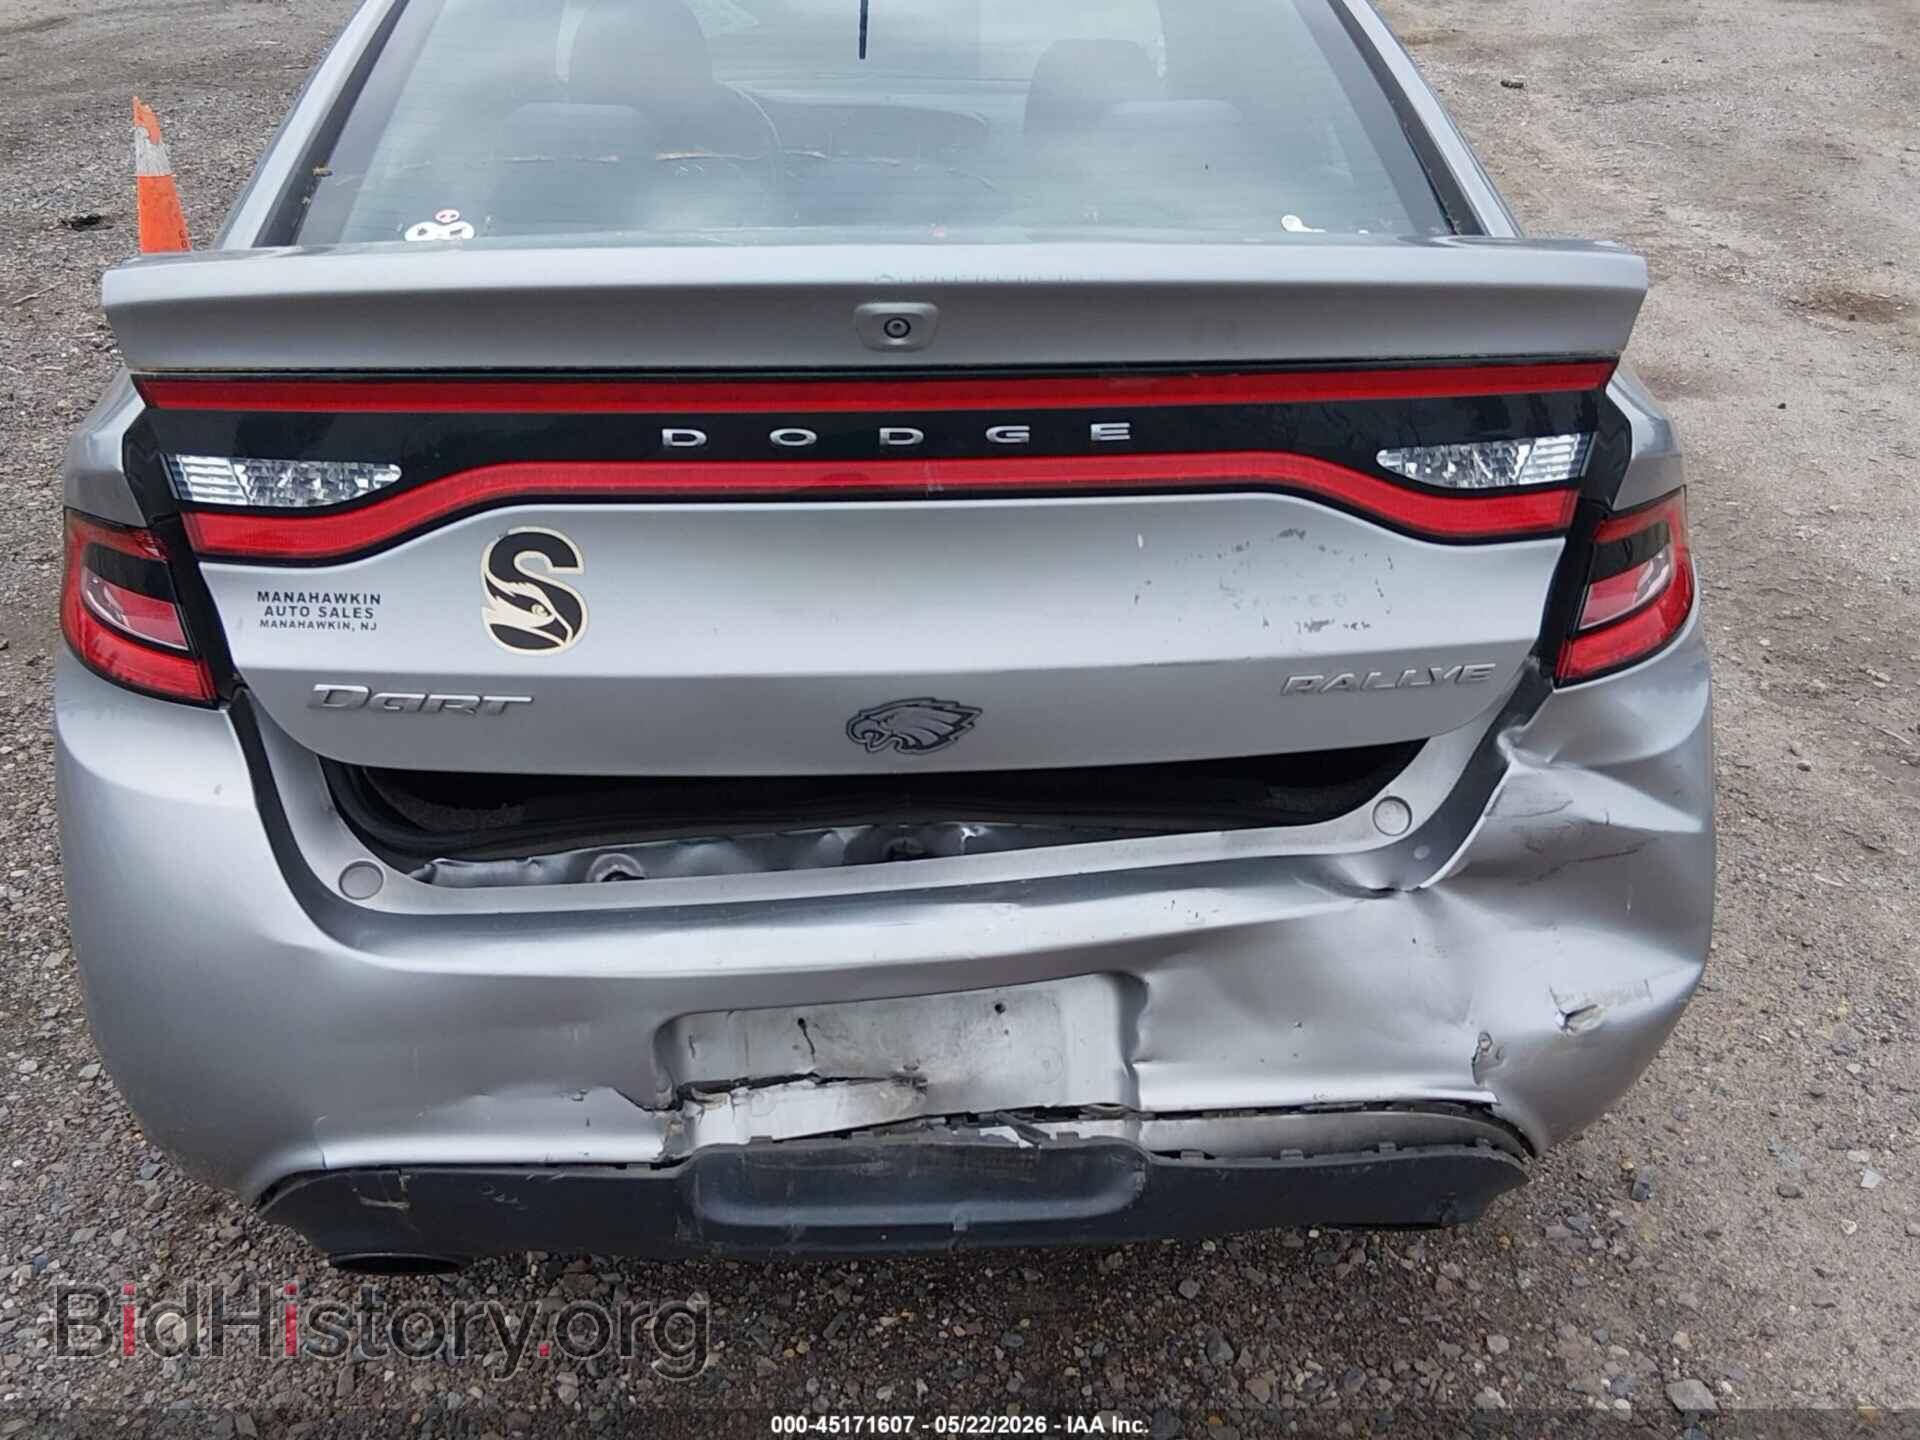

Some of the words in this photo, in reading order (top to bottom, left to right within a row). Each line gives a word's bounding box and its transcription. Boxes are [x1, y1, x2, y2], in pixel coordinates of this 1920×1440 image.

[661, 422, 1132, 448] DODGE
[256, 591, 382, 605] MANAHAWKIN
[264, 605, 311, 617] AUTO
[318, 606, 375, 620] SALES
[259, 619, 356, 632] MANAHAWKIN,
[360, 622, 377, 631] NJ
[1280, 663, 1497, 696] RALLYE
